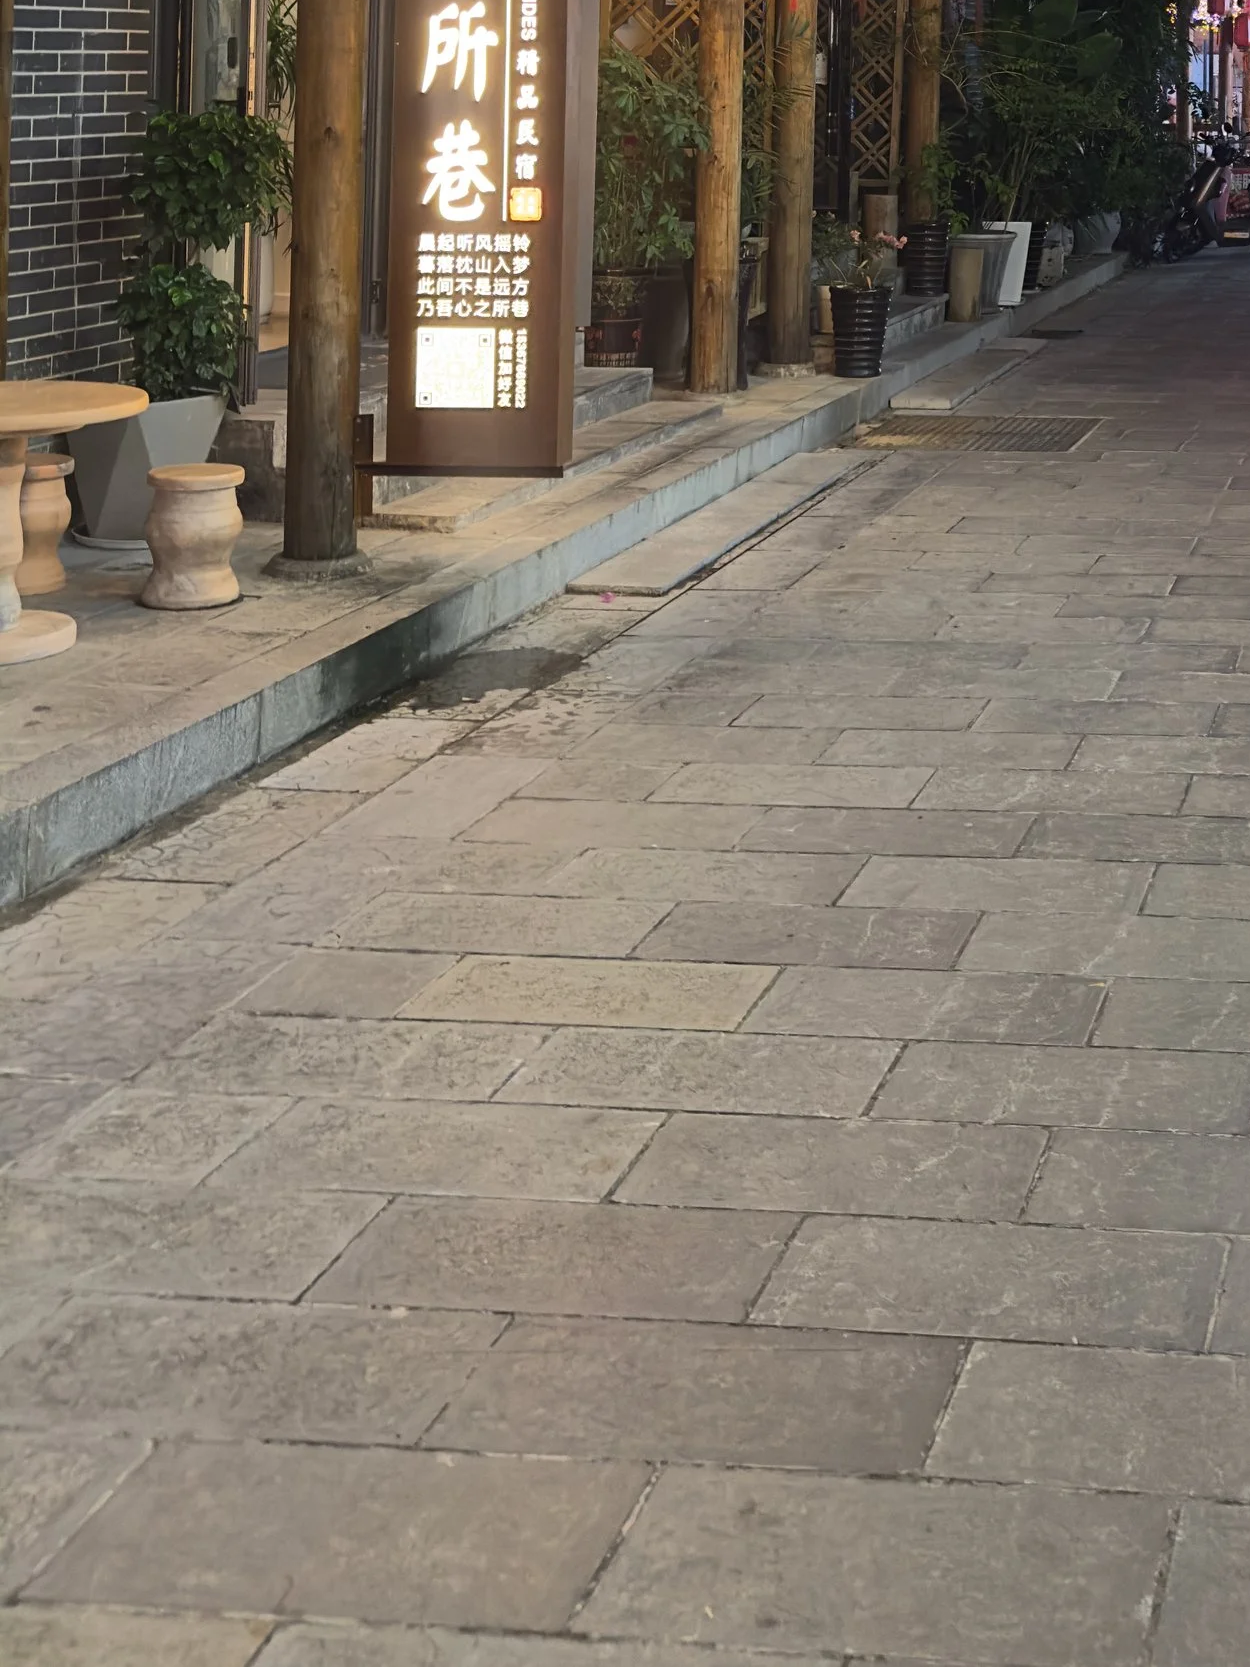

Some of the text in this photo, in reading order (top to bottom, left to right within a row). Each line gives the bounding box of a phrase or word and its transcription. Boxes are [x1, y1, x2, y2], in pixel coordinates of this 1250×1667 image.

[515, 48, 541, 180] 精品民宿
[416, 277, 530, 296] 此间不是远方
[416, 298, 530, 318] 乃吾心之所巷
